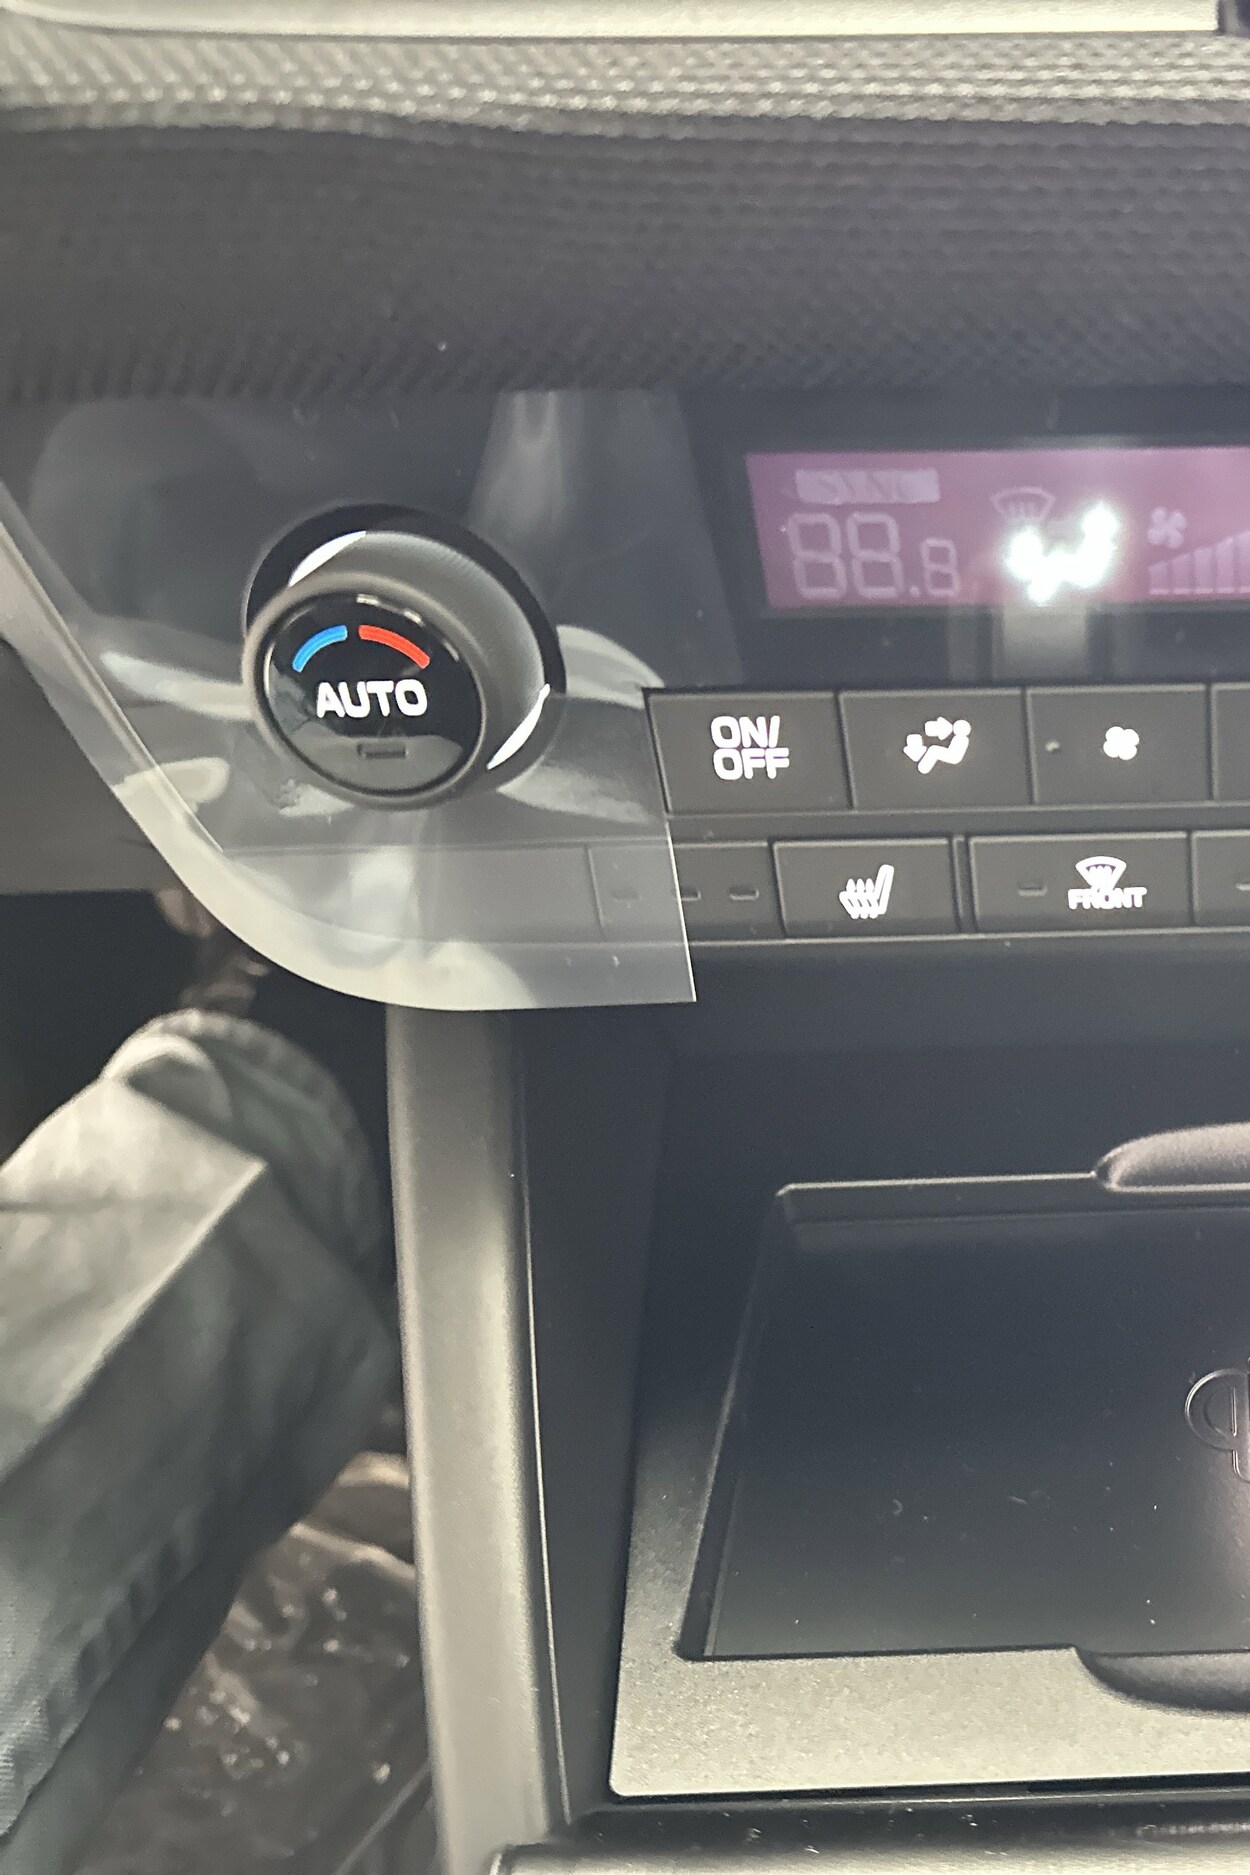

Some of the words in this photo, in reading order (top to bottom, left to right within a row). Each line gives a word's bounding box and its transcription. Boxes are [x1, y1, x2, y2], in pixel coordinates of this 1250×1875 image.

[316, 678, 428, 718] AUTO
[711, 715, 780, 749] ON/
[713, 746, 790, 780] OFF
[1067, 885, 1148, 911] FRONT
